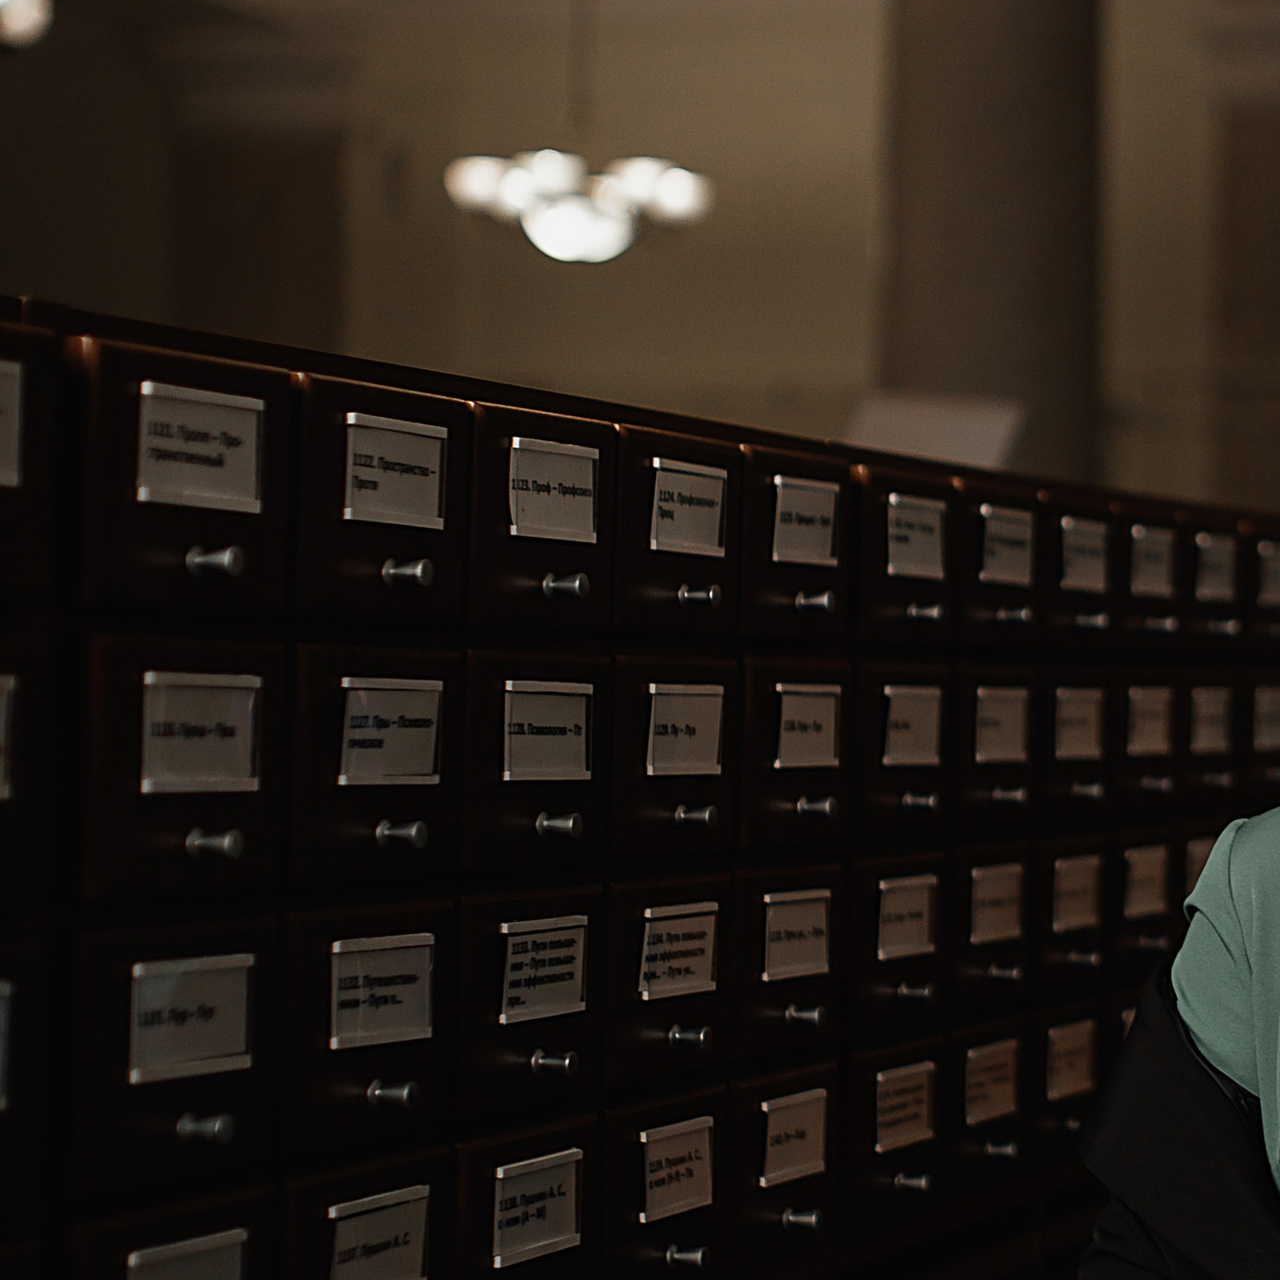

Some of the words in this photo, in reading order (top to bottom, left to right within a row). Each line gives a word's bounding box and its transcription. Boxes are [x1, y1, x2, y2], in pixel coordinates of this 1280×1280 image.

[512, 479, 531, 491] 1123.
[532, 480, 551, 495] Проф
[658, 490, 675, 503] 1124.
[665, 932, 681, 945] Пути
[531, 940, 548, 954] Пути
[529, 957, 547, 972] Пути
